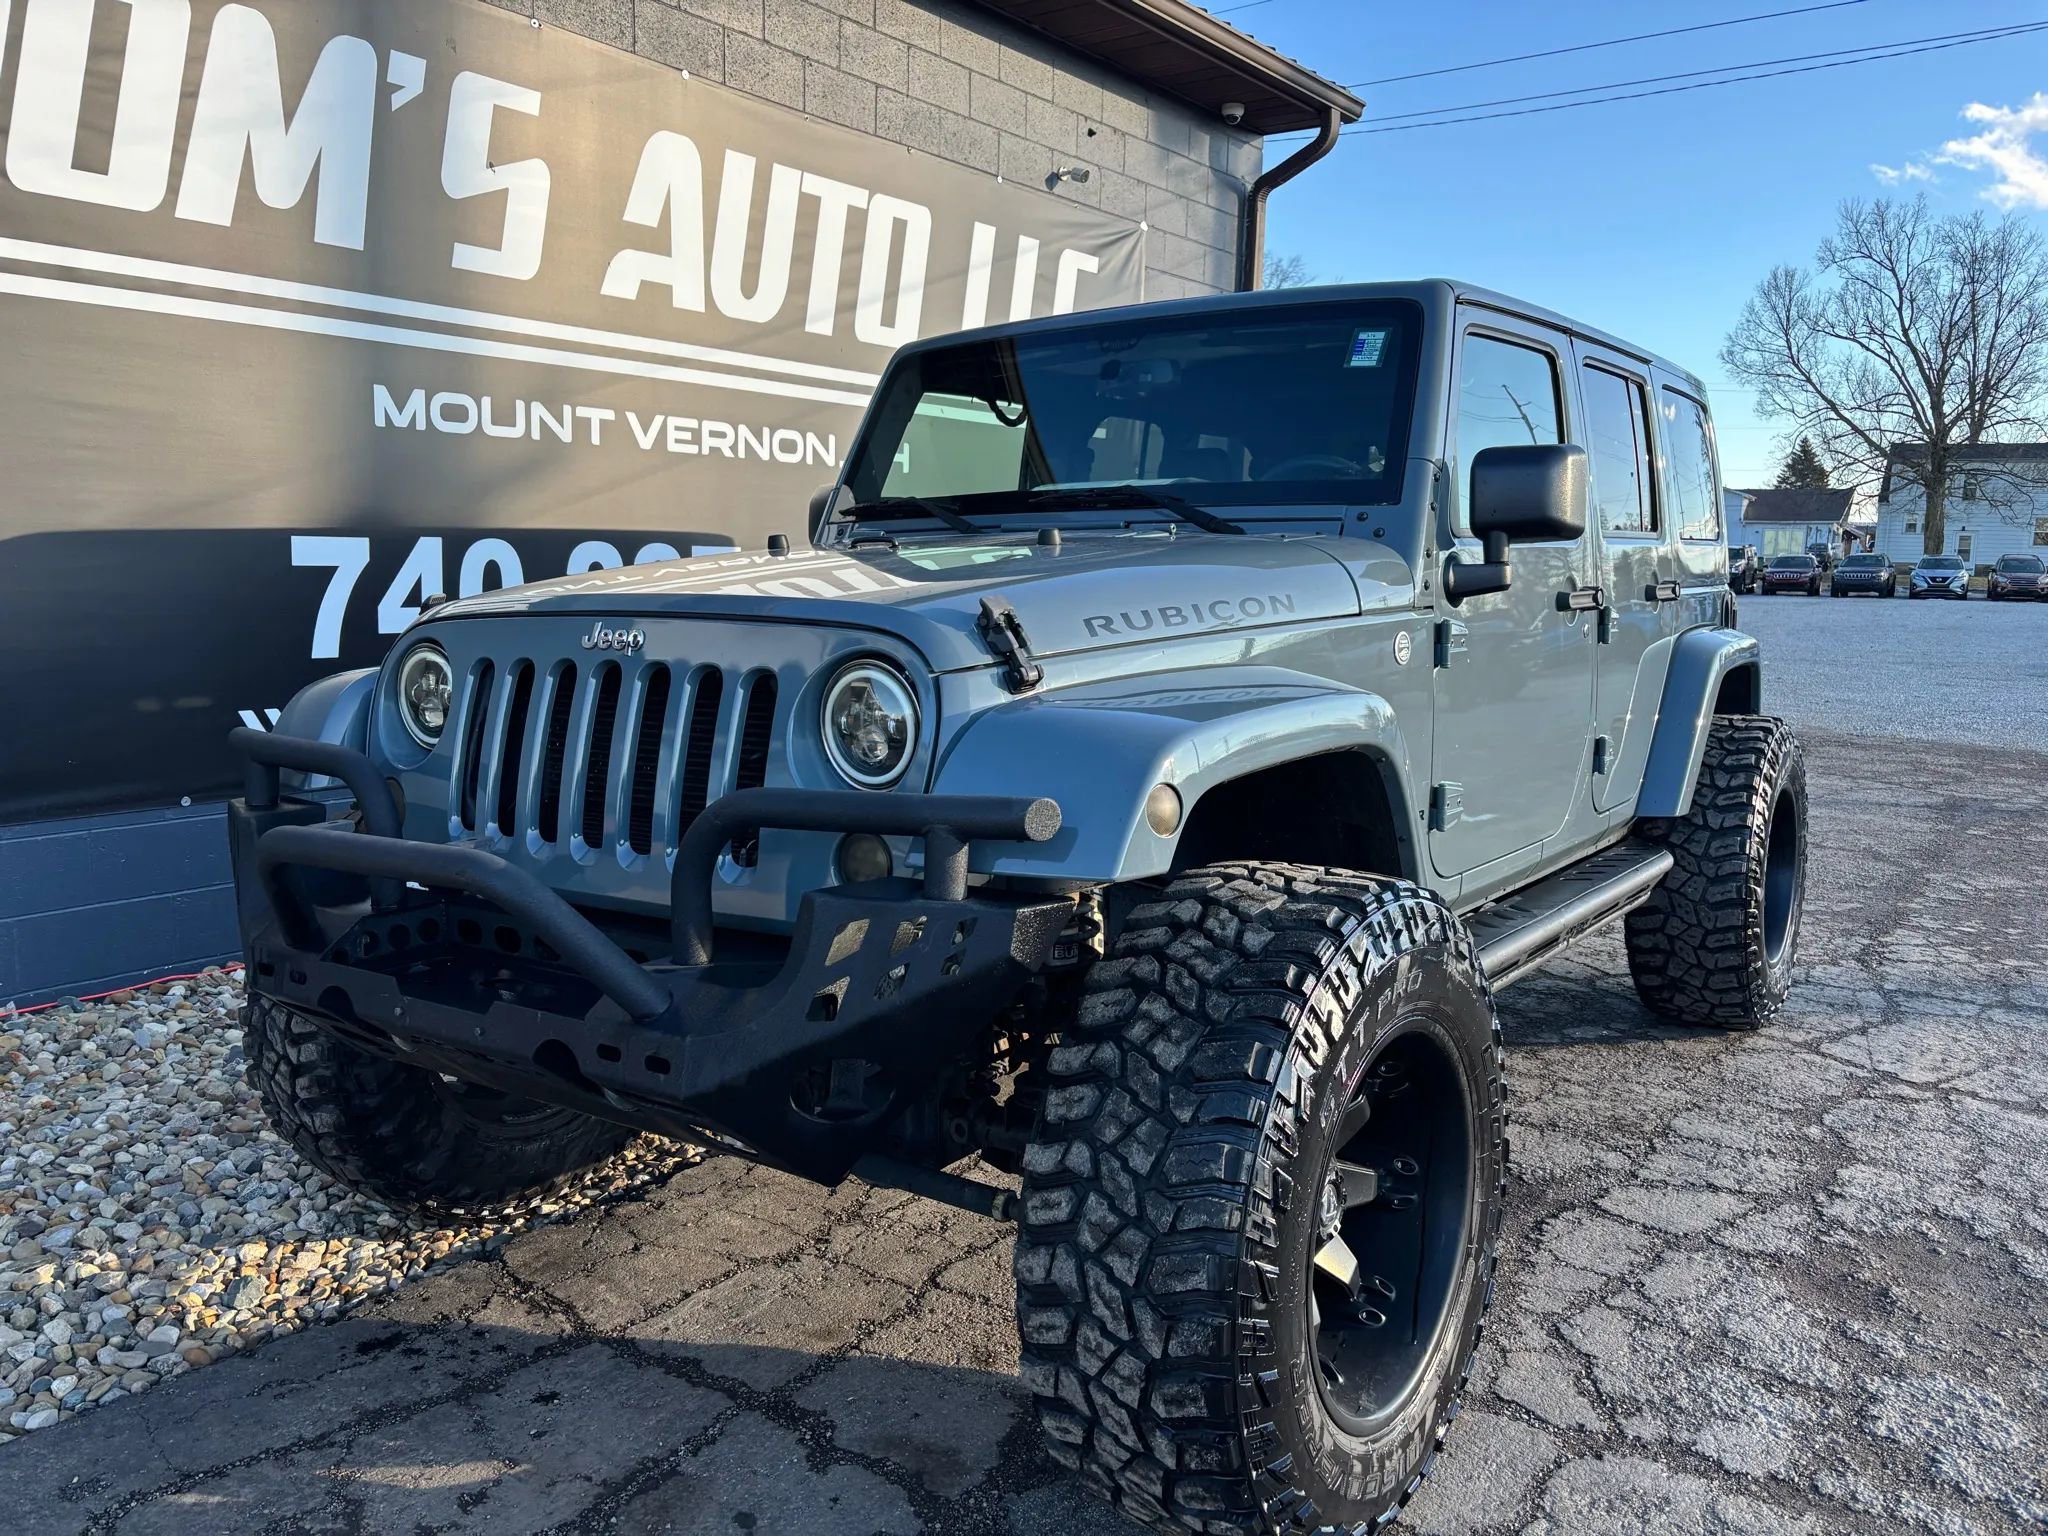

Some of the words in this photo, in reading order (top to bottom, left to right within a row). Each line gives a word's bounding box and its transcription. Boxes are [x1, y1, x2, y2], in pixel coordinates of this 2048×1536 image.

[0, 0, 551, 281] OM'S
[600, 130, 932, 349] AUTO
[373, 384, 615, 446] MOUNT
[581, 621, 645, 656] Jeep
[1083, 594, 1297, 637] RUBICON
